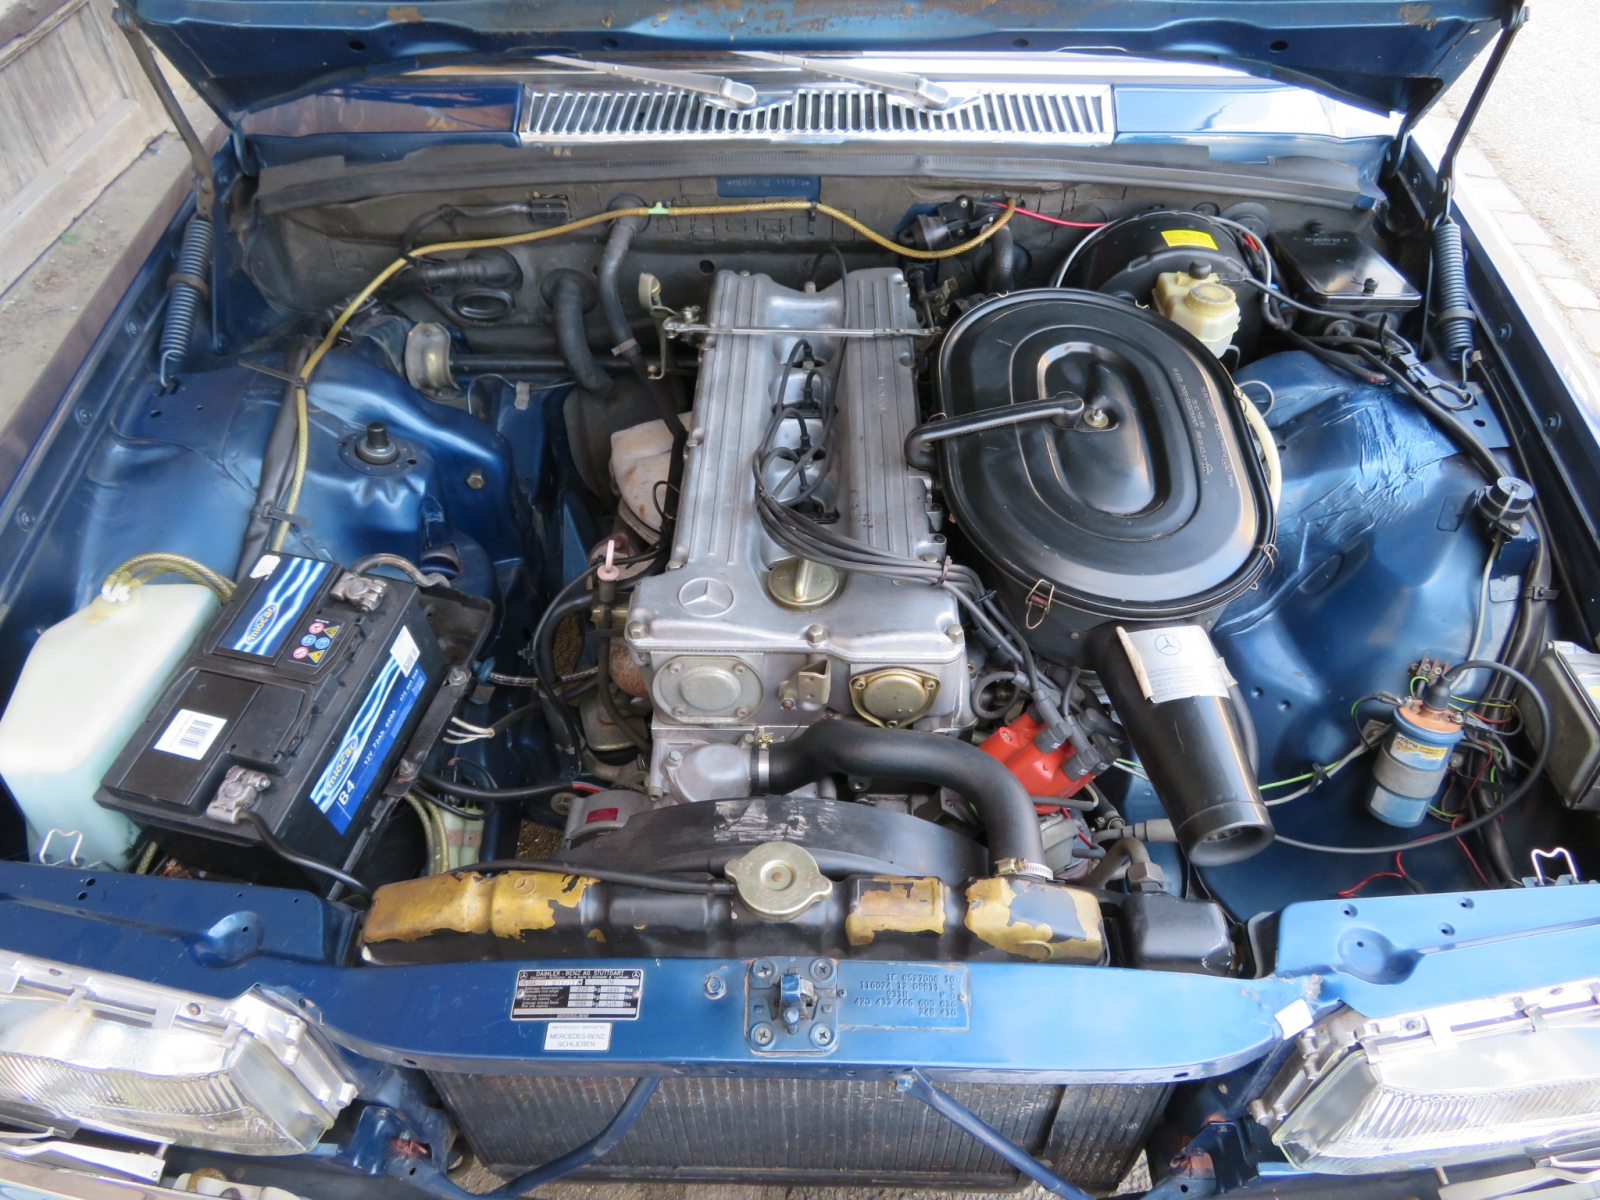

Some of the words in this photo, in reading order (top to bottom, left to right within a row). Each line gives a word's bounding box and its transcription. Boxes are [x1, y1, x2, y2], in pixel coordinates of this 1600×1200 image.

[363, 751, 374, 765] 12V
[372, 731, 386, 749] 72Ah
[860, 981, 891, 989] 116024
[897, 981, 908, 990] 12
